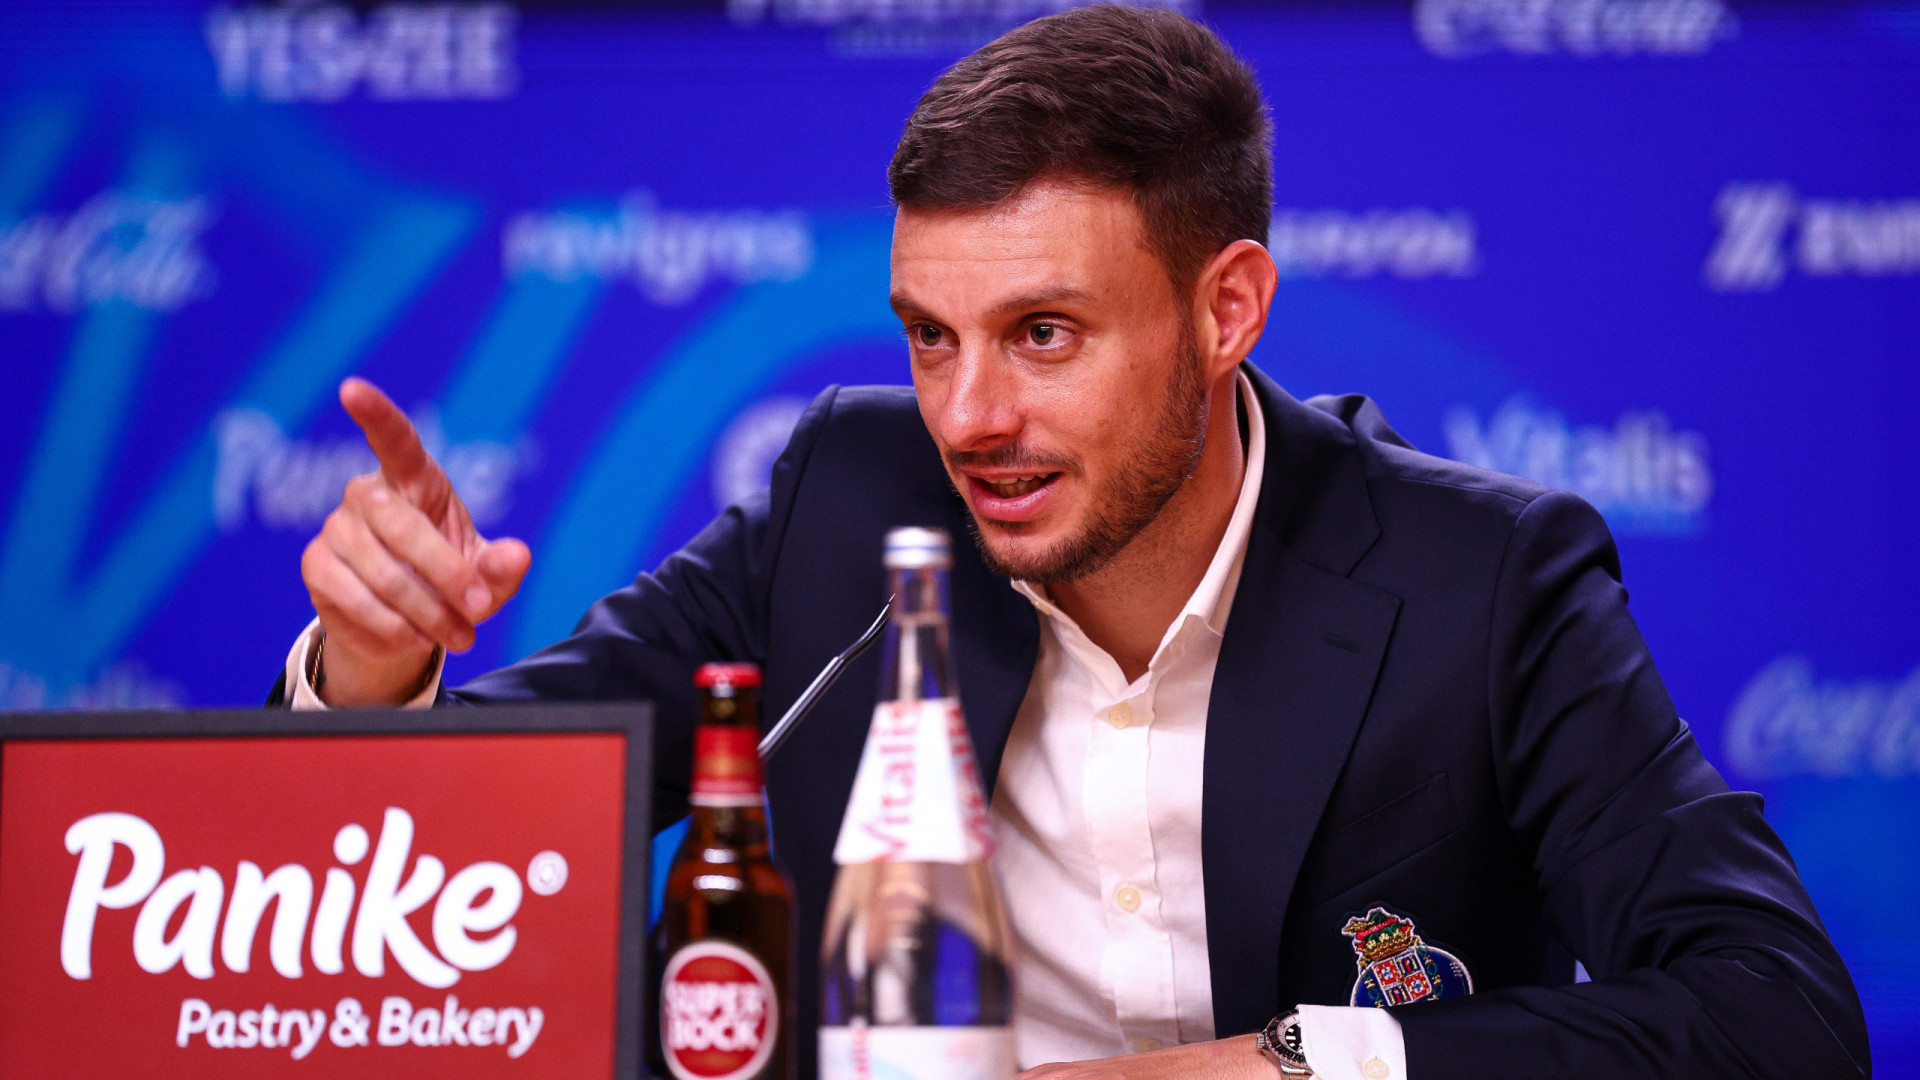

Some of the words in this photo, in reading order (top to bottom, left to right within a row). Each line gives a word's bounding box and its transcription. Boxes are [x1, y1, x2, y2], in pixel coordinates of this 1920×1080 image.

[60, 806, 523, 989] Panike
[176, 998, 326, 1060] Pastry
[329, 997, 370, 1048] &
[376, 995, 544, 1059] Bakery
